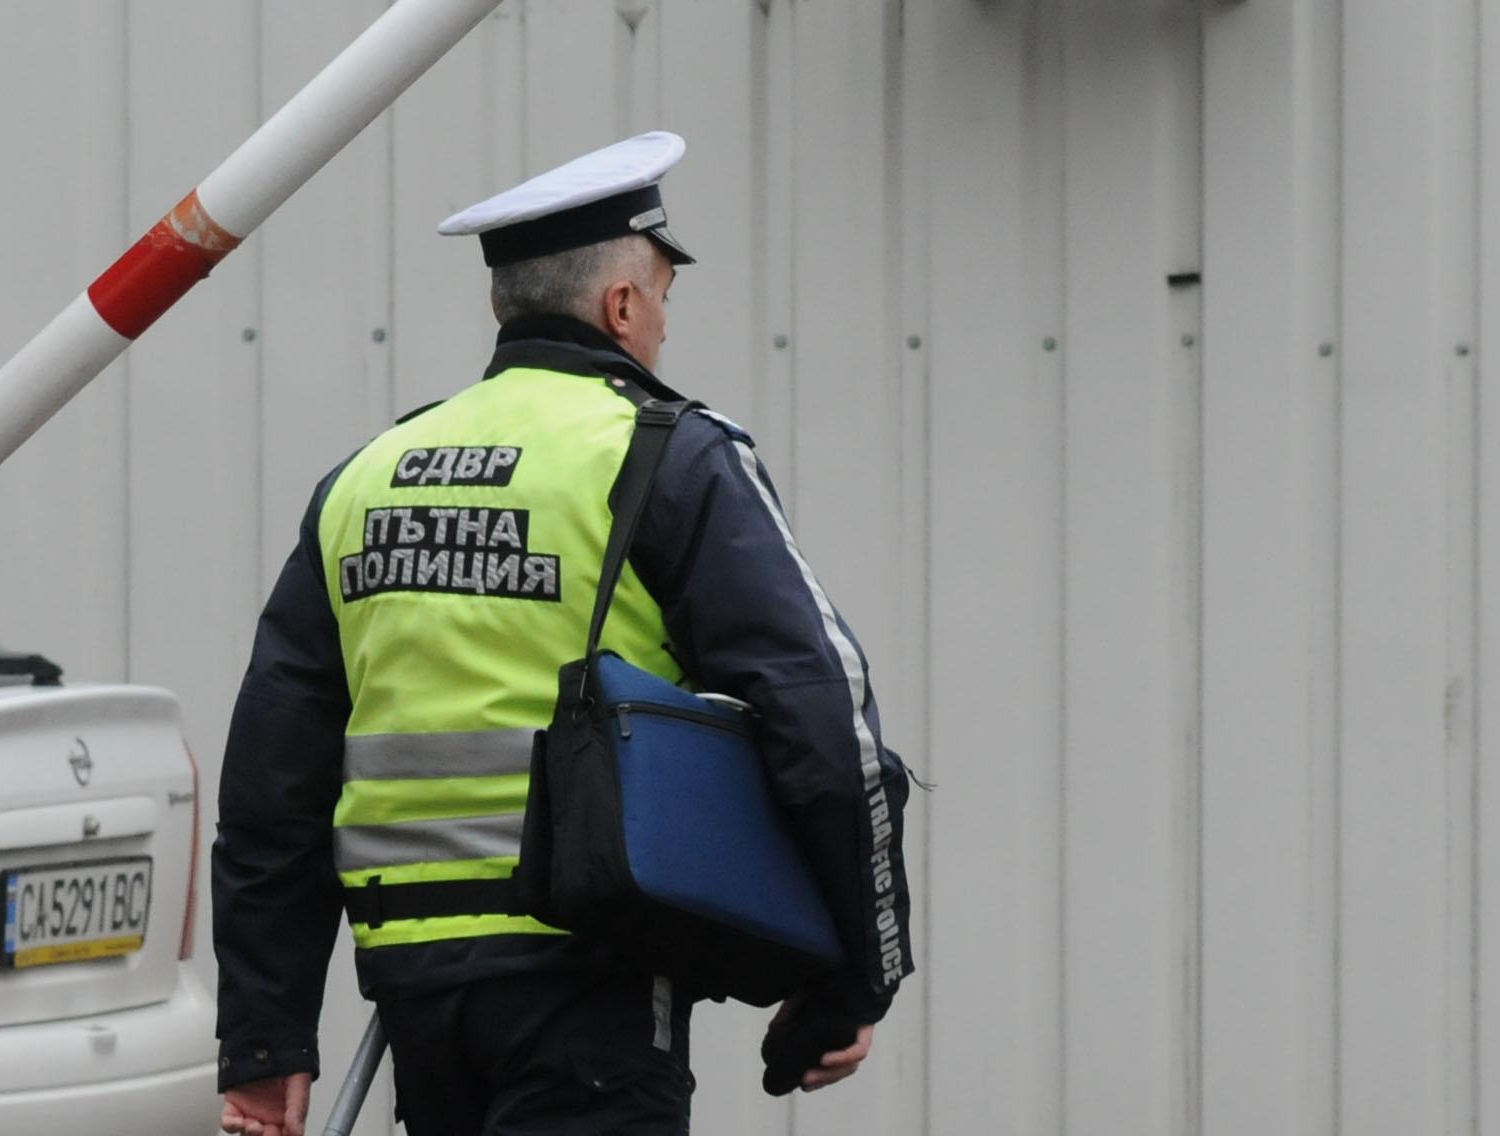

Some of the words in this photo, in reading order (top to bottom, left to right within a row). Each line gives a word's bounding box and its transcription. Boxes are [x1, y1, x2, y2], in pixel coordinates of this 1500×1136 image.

[396, 446, 518, 485] СДВР
[363, 508, 523, 548] ПЪТНА
[340, 549, 557, 595] ПОЛИЦИЯ
[876, 892, 902, 986] POLICE
